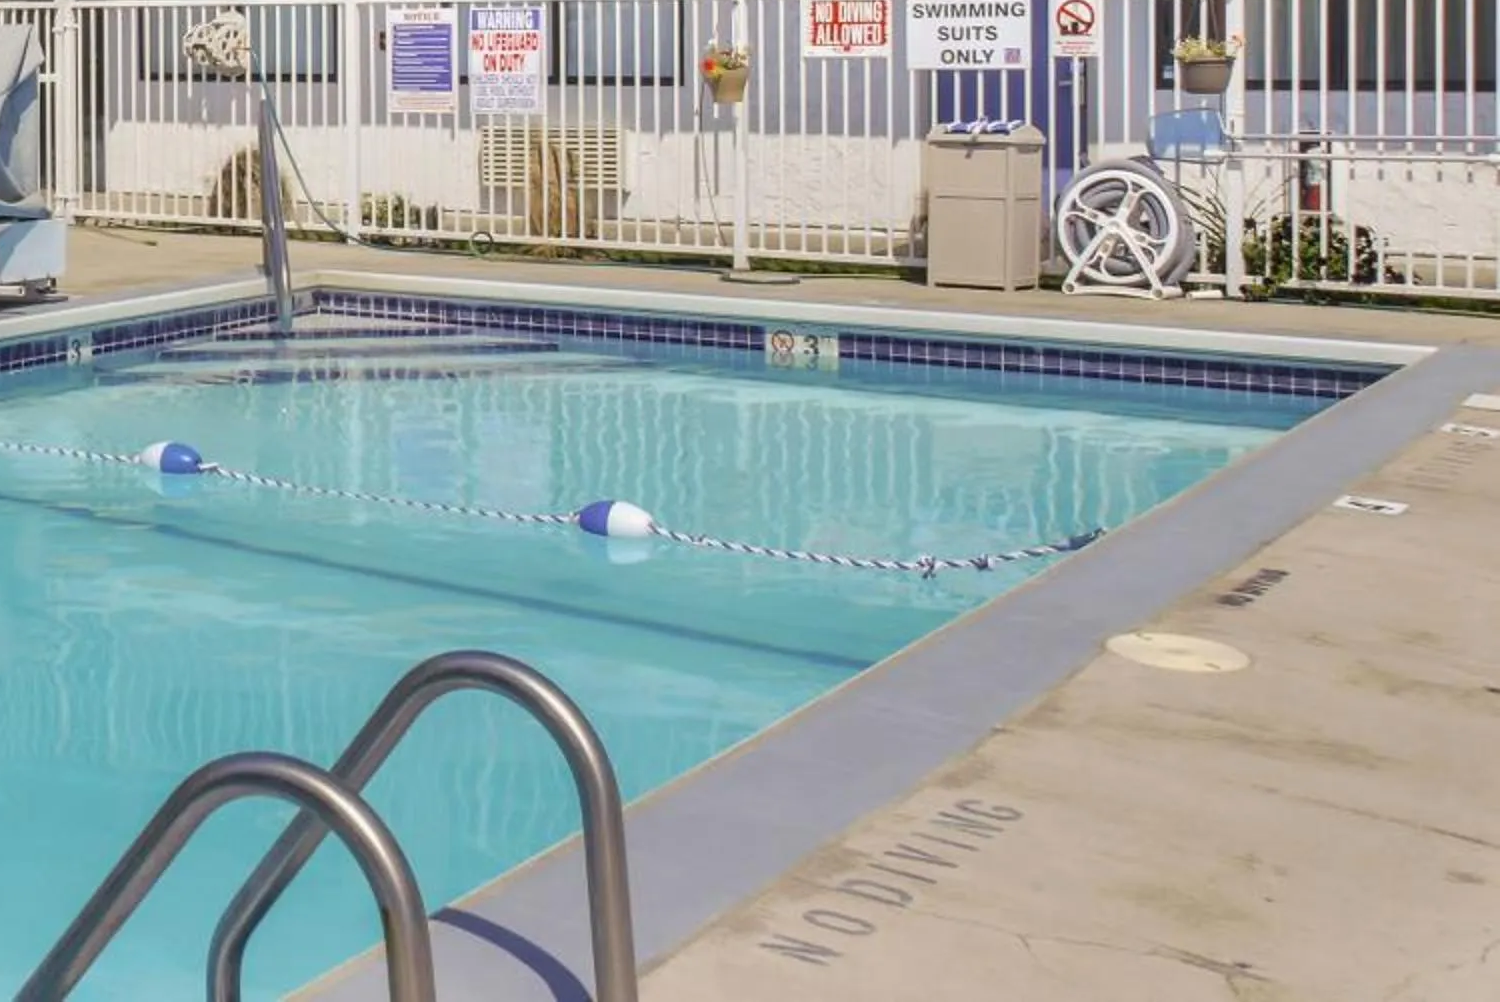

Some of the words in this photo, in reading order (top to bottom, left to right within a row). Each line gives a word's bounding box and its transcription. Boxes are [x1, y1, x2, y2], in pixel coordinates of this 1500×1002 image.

[815, 1, 833, 22] NO
[839, 1, 882, 22] DIVING
[912, 2, 1026, 19] SWIMMING
[477, 11, 534, 29] WARNING
[471, 33, 484, 50] NO
[488, 33, 538, 50] LIFEGUARD
[816, 24, 882, 45] ALLOWED
[937, 25, 998, 41] SUITS
[484, 53, 496, 71] ON
[500, 53, 526, 71] DUTY
[940, 49, 995, 64] ONLY
[803, 334, 819, 354] 3
[757, 908, 877, 967] NO
[835, 799, 1024, 909] DIVING
